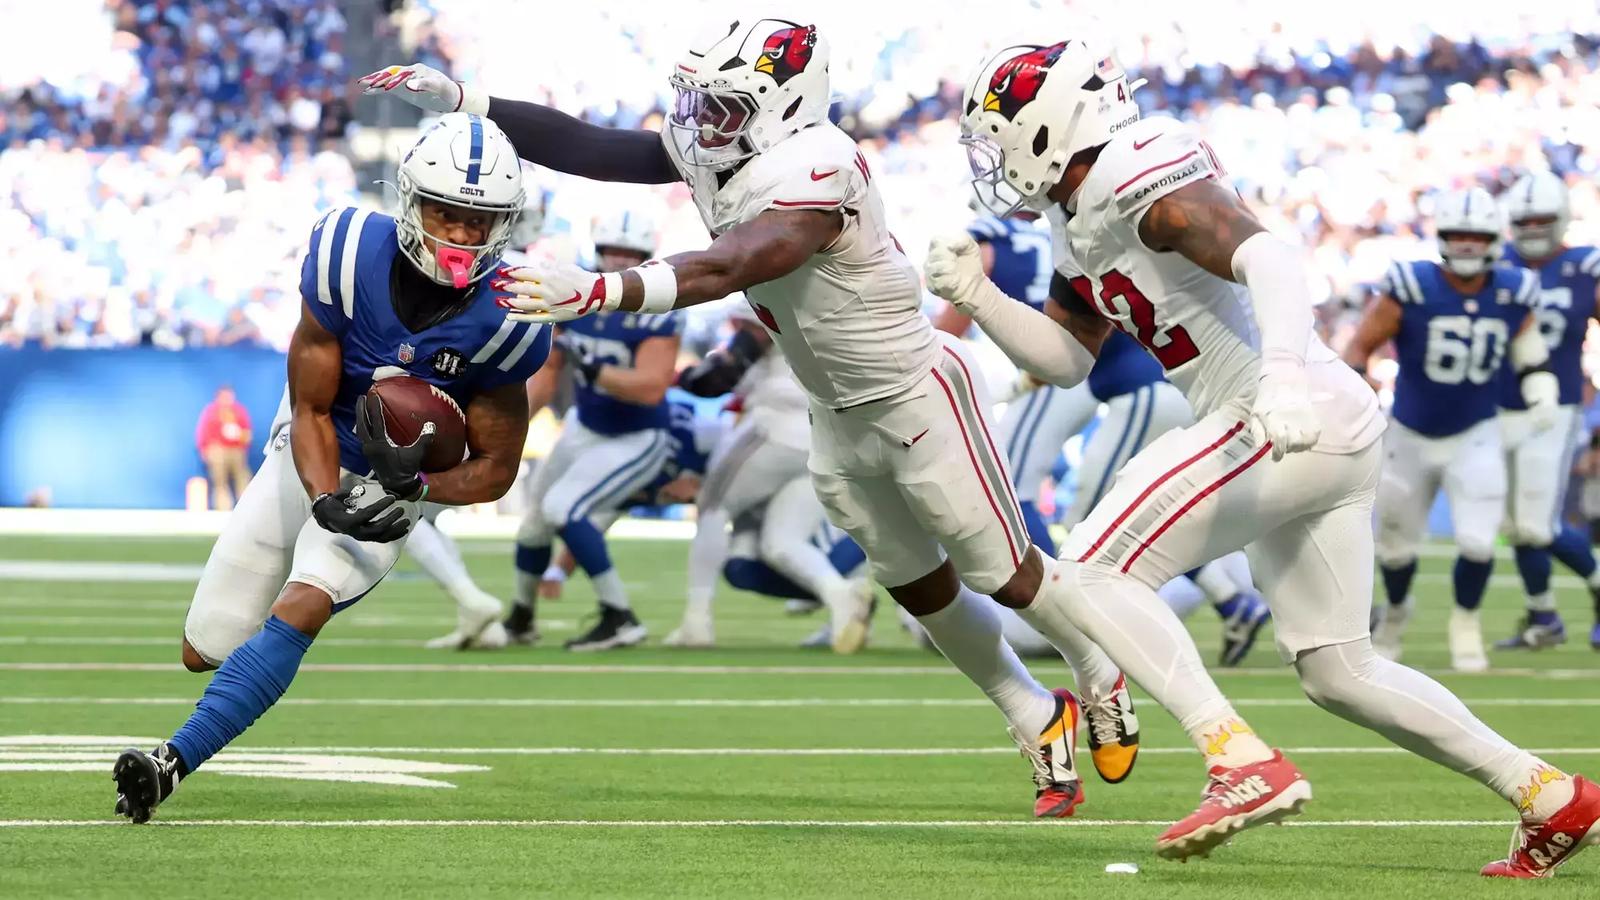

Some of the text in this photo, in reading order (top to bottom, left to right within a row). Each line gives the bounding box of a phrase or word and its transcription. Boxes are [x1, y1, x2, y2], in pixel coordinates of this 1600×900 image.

[460, 186, 485, 197] COLTS
[1134, 164, 1198, 199] CARDINALS
[1424, 315, 1508, 385] 60
[1528, 831, 1574, 867] RAB
